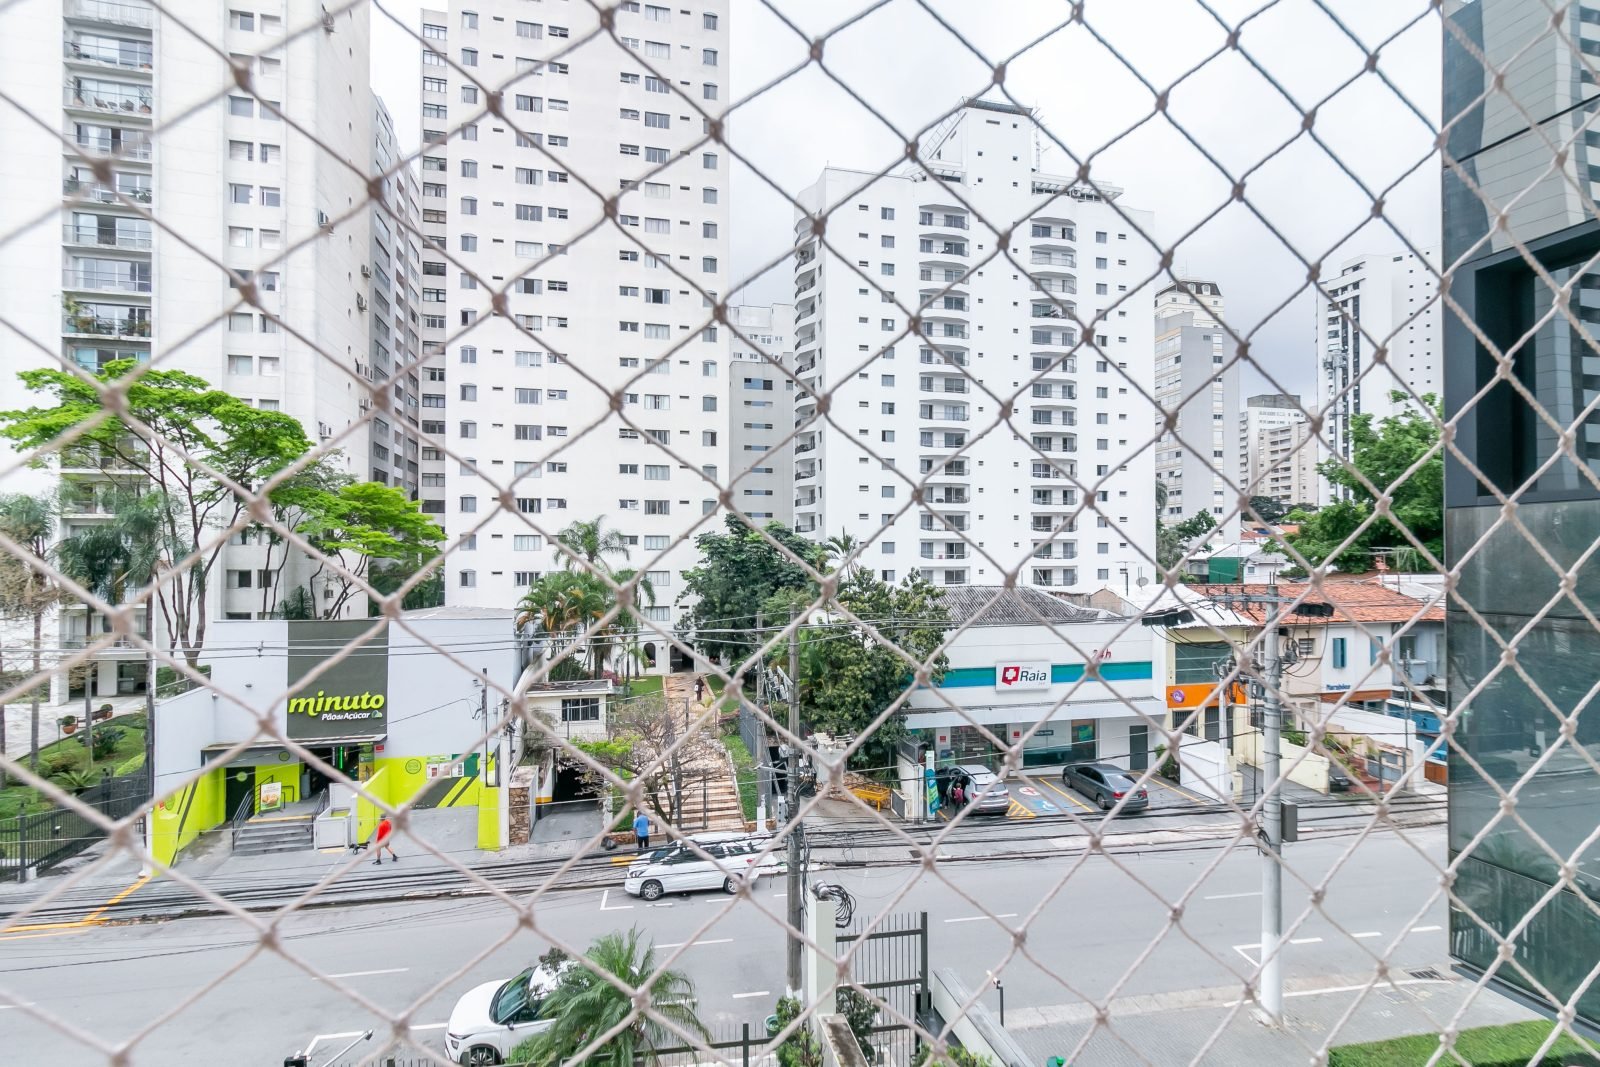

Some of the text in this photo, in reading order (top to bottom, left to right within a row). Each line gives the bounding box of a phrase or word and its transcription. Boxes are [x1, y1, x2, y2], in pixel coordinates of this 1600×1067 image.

[1019, 670, 1047, 682] Raia
[288, 690, 385, 716] minuto
[343, 711, 370, 720] Açúcar
